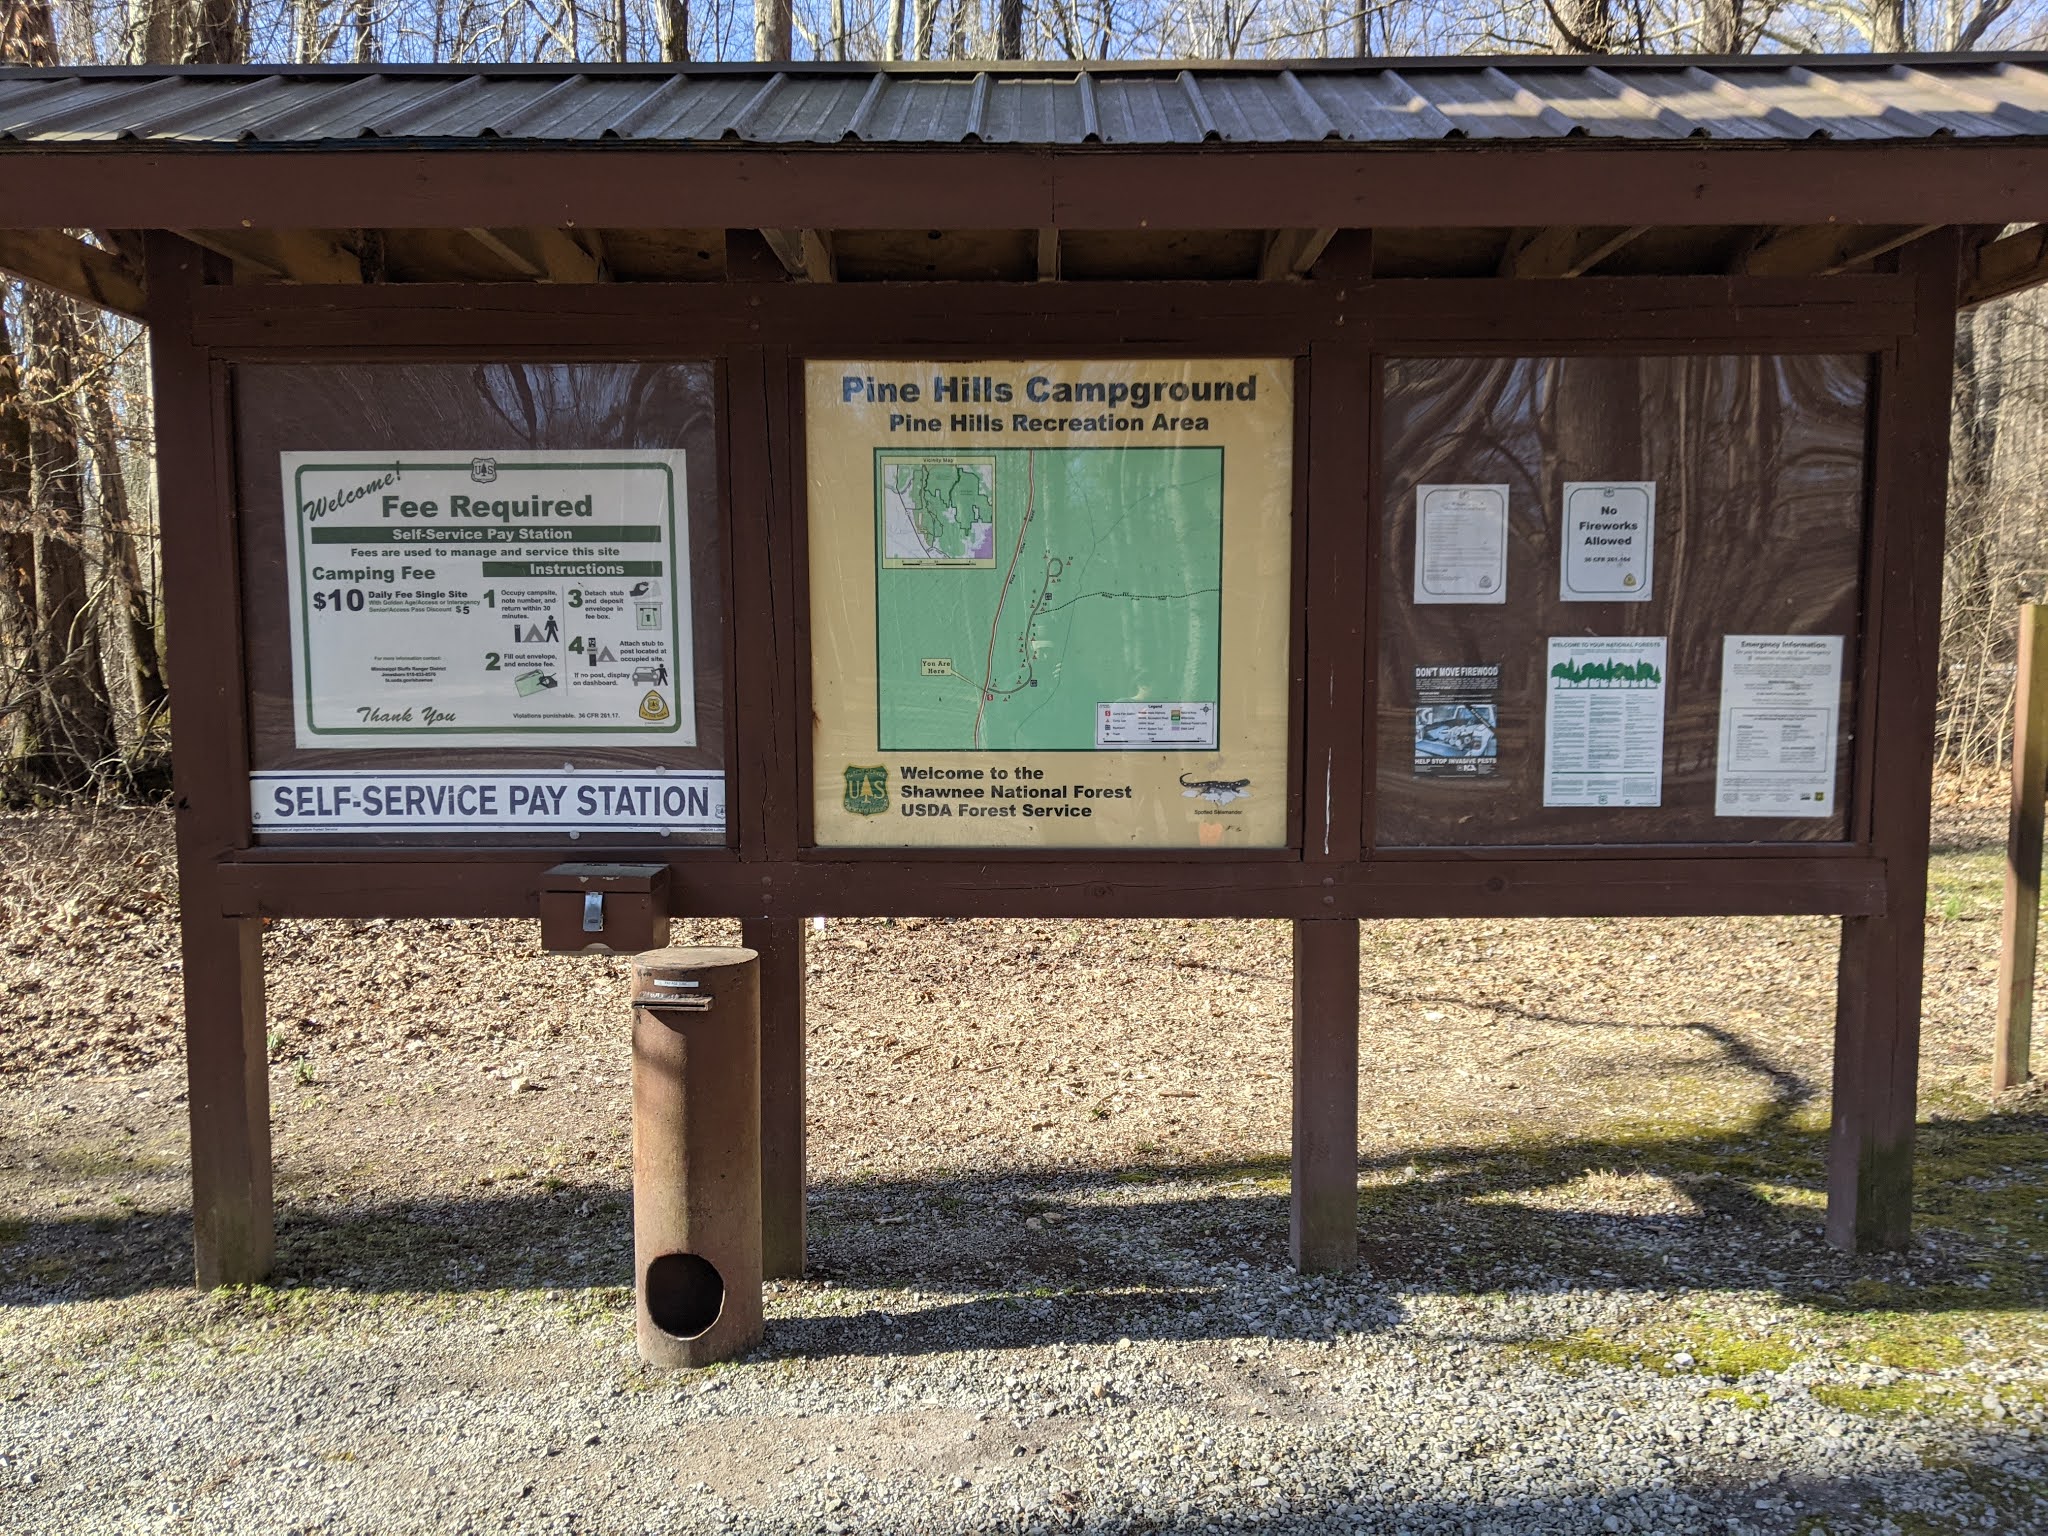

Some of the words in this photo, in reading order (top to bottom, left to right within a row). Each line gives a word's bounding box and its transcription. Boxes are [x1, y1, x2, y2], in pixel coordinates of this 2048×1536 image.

[842, 376, 921, 403] Pine
[933, 376, 1014, 403] Hills
[1026, 375, 1257, 409] Campground
[889, 414, 942, 432] Pine
[950, 414, 1004, 432] Hills
[1012, 413, 1144, 432] Recreation
[1151, 413, 1209, 431] Area
[302, 460, 402, 522] Welcome!
[382, 495, 439, 518] Fee
[450, 494, 593, 523] Required
[1600, 505, 1618, 516] No
[1579, 520, 1638, 531] Fireworks
[392, 528, 483, 541] Self-Service
[487, 528, 515, 543] Pay
[518, 527, 573, 540] Station
[1584, 536, 1632, 546] Allowed
[351, 549, 379, 558] Fees
[381, 550, 400, 558] are
[404, 549, 433, 558] used
[435, 549, 447, 558] to
[450, 549, 497, 559] manage
[500, 548, 522, 557] and
[525, 548, 571, 557] service
[572, 547, 595, 557] this
[597, 547, 620, 557] site
[312, 566, 395, 583] Camping
[401, 565, 436, 580] Fee
[530, 563, 625, 575] Instructions
[312, 588, 365, 612] $10
[368, 591, 392, 600] Daily
[395, 591, 413, 599] Fee
[415, 590, 446, 600] Single
[448, 590, 468, 599] Site
[483, 589, 495, 608] 1
[568, 589, 583, 608] 3
[568, 636, 584, 655] 4
[1740, 641, 1781, 649] Emergency
[485, 652, 501, 671] 2
[1415, 667, 1438, 678] DON'T
[1439, 667, 1460, 677] MOVE
[1460, 666, 1499, 677] FIREWOOD
[356, 706, 413, 723] Thank
[421, 706, 456, 726] You
[900, 766, 985, 780] Welcome
[990, 766, 1008, 780] to
[1014, 766, 1044, 780] the
[901, 785, 985, 798] Shawnee
[991, 785, 1067, 798] National
[1073, 785, 1132, 798] Forest
[273, 784, 498, 817] SELF-SERVICE
[509, 784, 568, 816] PAY
[576, 784, 709, 817] STATION
[901, 803, 952, 817] USDA
[958, 803, 1016, 817] Forest
[1022, 803, 1092, 817] Service
